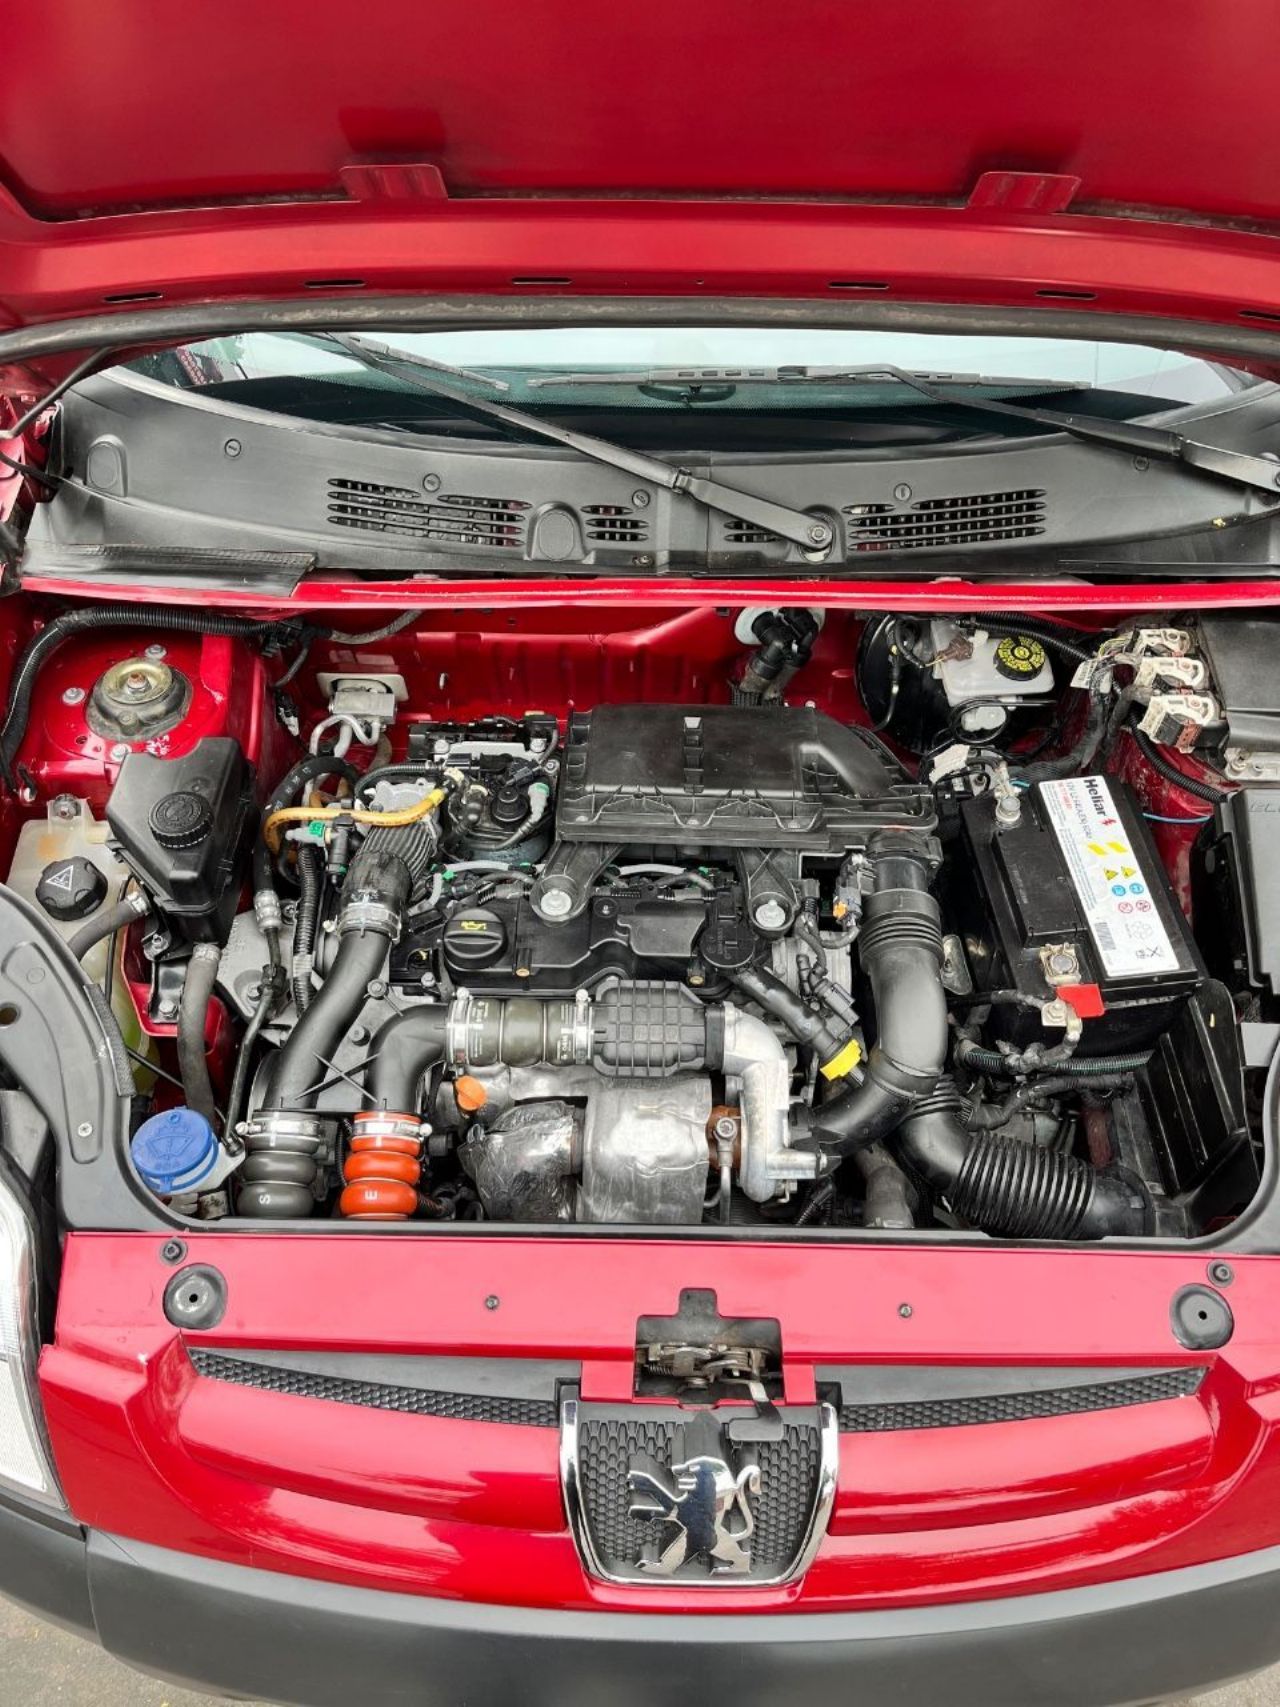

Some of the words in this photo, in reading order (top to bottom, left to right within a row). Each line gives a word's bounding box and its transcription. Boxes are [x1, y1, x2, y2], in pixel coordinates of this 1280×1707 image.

[1084, 779, 1106, 816] Heliar
[259, 1194, 270, 1205] S
[364, 1189, 378, 1200] E
